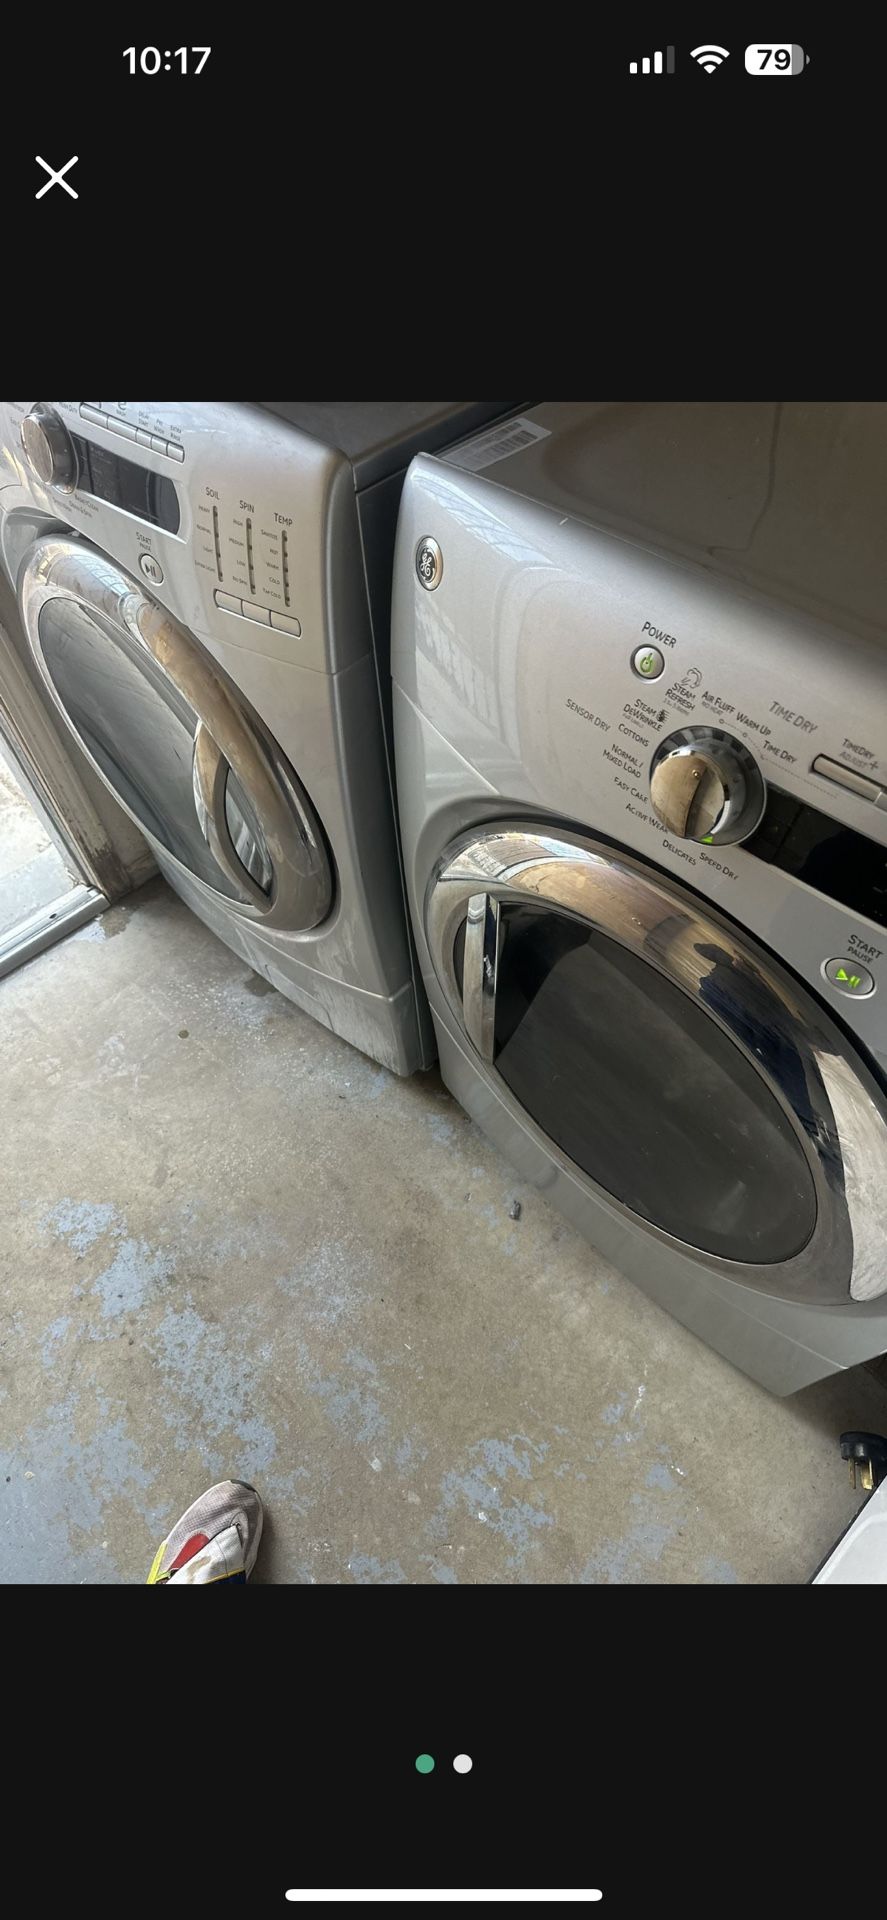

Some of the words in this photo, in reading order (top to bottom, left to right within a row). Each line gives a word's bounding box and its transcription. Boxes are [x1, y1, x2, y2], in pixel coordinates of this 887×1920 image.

[205, 486, 220, 500] SOIL
[239, 500, 255, 513] SPIN
[273, 512, 293, 527] TEMP
[136, 531, 152, 546] START
[641, 621, 677, 649] POWER
[665, 688, 696, 711] REFRESH
[671, 682, 697, 700] STEAM
[701, 690, 715, 704] AIR
[715, 697, 736, 715] FLUFF
[565, 698, 594, 723] SENSOR
[594, 715, 611, 733] DRY
[634, 698, 657, 717] STEAM
[768, 700, 795, 723] TIME
[792, 715, 818, 735] DRY
[618, 723, 650, 748] COTTONS
[736, 711, 760, 731] WARM
[759, 724, 772, 737] UP
[602, 750, 623, 767] MIXED
[623, 762, 642, 778] LOAD
[611, 743, 638, 767] NORMAL
[762, 740, 780, 756] TIME
[779, 750, 797, 765] DRY
[613, 776, 630, 791] EASY
[625, 803, 648, 824] ACTIVE
[662, 839, 697, 866] DELICATES
[847, 934, 883, 960] START
[847, 945, 874, 966] PAUSE
